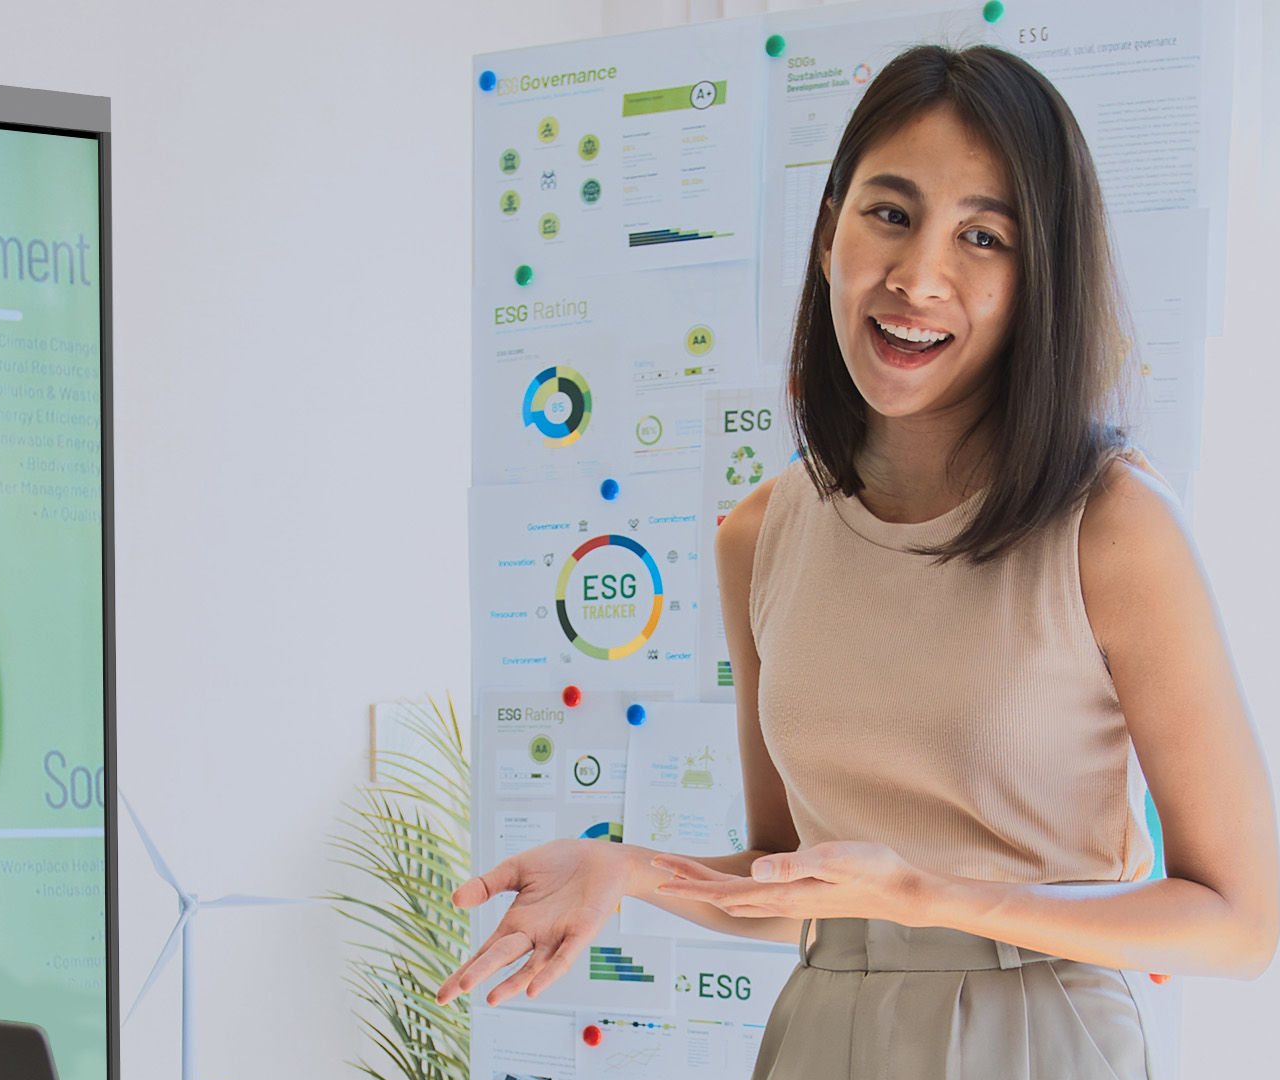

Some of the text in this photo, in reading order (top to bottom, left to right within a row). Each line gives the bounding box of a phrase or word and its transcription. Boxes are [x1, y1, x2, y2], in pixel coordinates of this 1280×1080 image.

[520, 66, 617, 91] Governance
[787, 68, 842, 82] Sustainable
[696, 88, 712, 100] A+
[495, 298, 588, 325] ESG Rating
[50, 336, 98, 357] Change
[692, 335, 707, 345] AA
[31, 360, 99, 378] Resources
[60, 386, 100, 403] Waste
[36, 409, 100, 429] Efficiency
[725, 409, 771, 432] ESG
[41, 507, 58, 520] Air
[527, 523, 570, 531] Governance
[498, 559, 535, 567] Innovation
[583, 573, 636, 601] ESG
[582, 603, 636, 620] TRACKER
[502, 657, 546, 665] Environment
[497, 707, 564, 724] ESG Rating
[534, 744, 548, 754] AA
[0, 859, 68, 874] Workplace
[699, 973, 751, 1000] ESG
